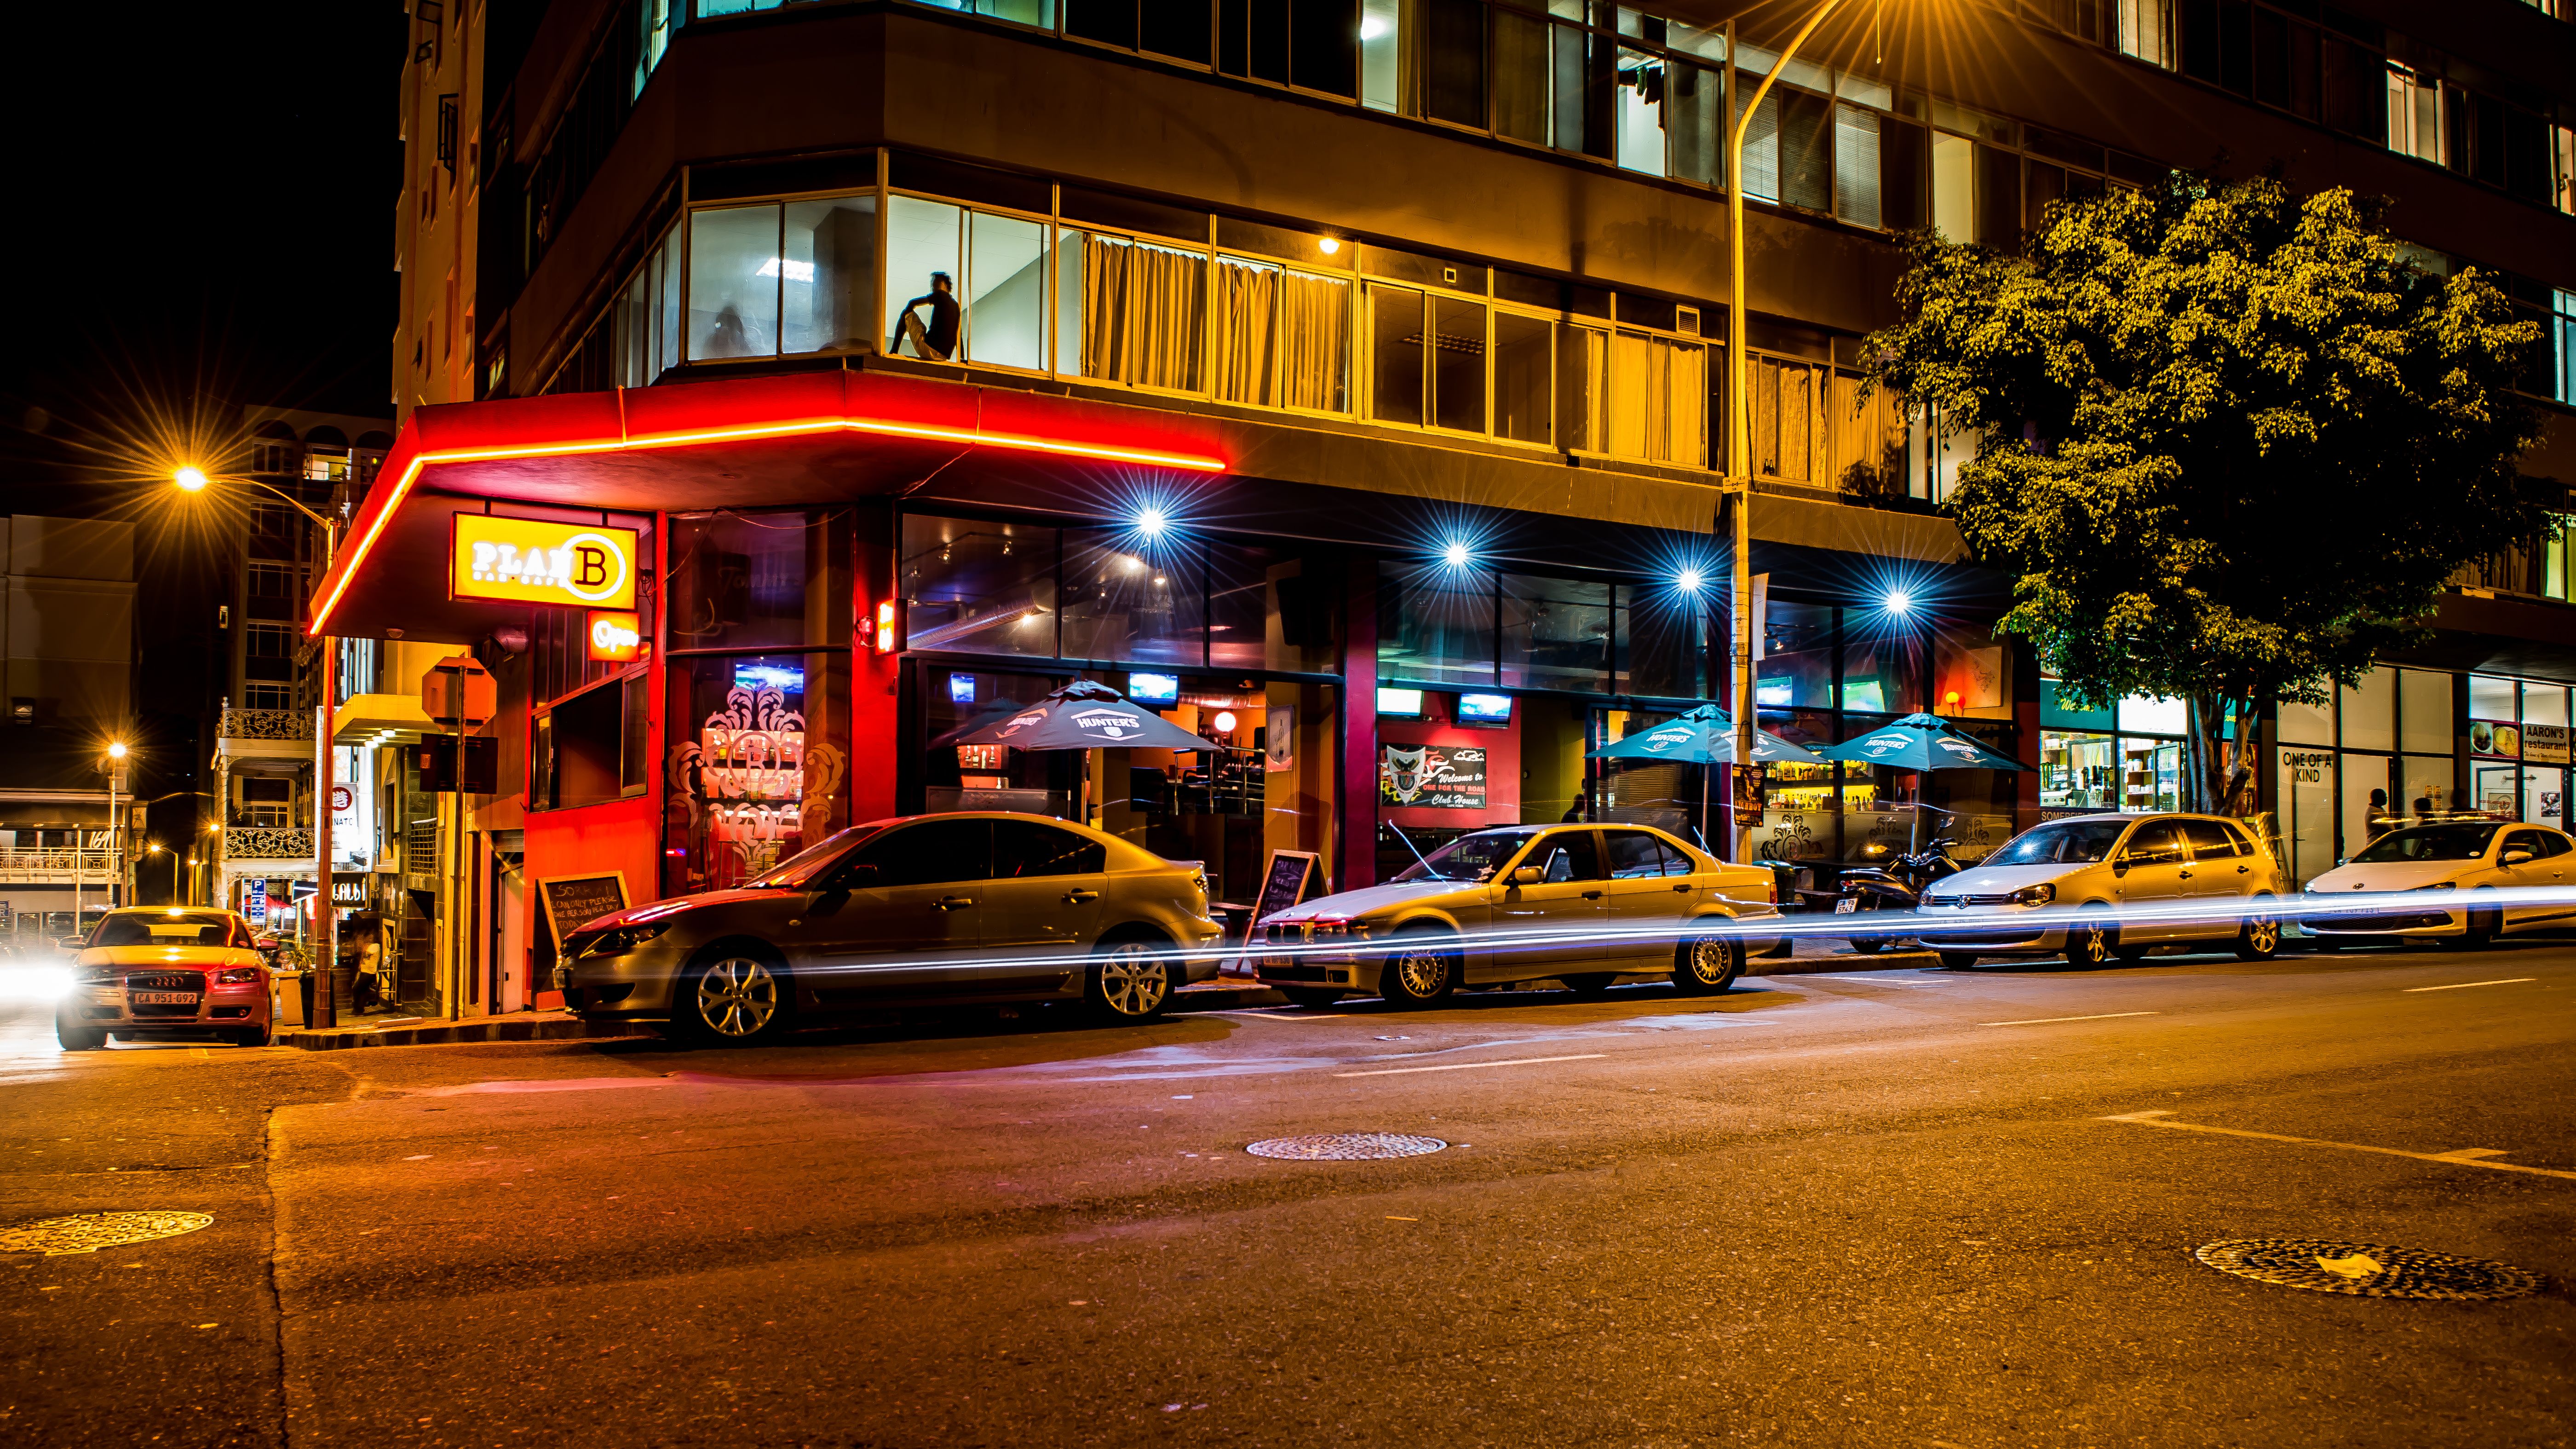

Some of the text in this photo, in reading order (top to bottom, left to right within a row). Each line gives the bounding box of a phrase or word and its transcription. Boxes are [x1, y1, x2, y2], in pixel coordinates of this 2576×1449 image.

[472, 542, 574, 579] PLAN
[575, 546, 606, 586] B
[1076, 717, 1140, 729] HUNTER'S
[2526, 725, 2564, 739] AARON'S
[2524, 739, 2567, 751] restaurant
[2283, 752, 2333, 768] ONE OF A
[1438, 773, 1484, 783] Welcome to
[2295, 769, 2320, 782] KIND
[1432, 794, 1479, 805] Club House
[570, 899, 586, 908] ONLY
[567, 908, 592, 917] PERSON
[138, 994, 195, 1003] CA 951-092
